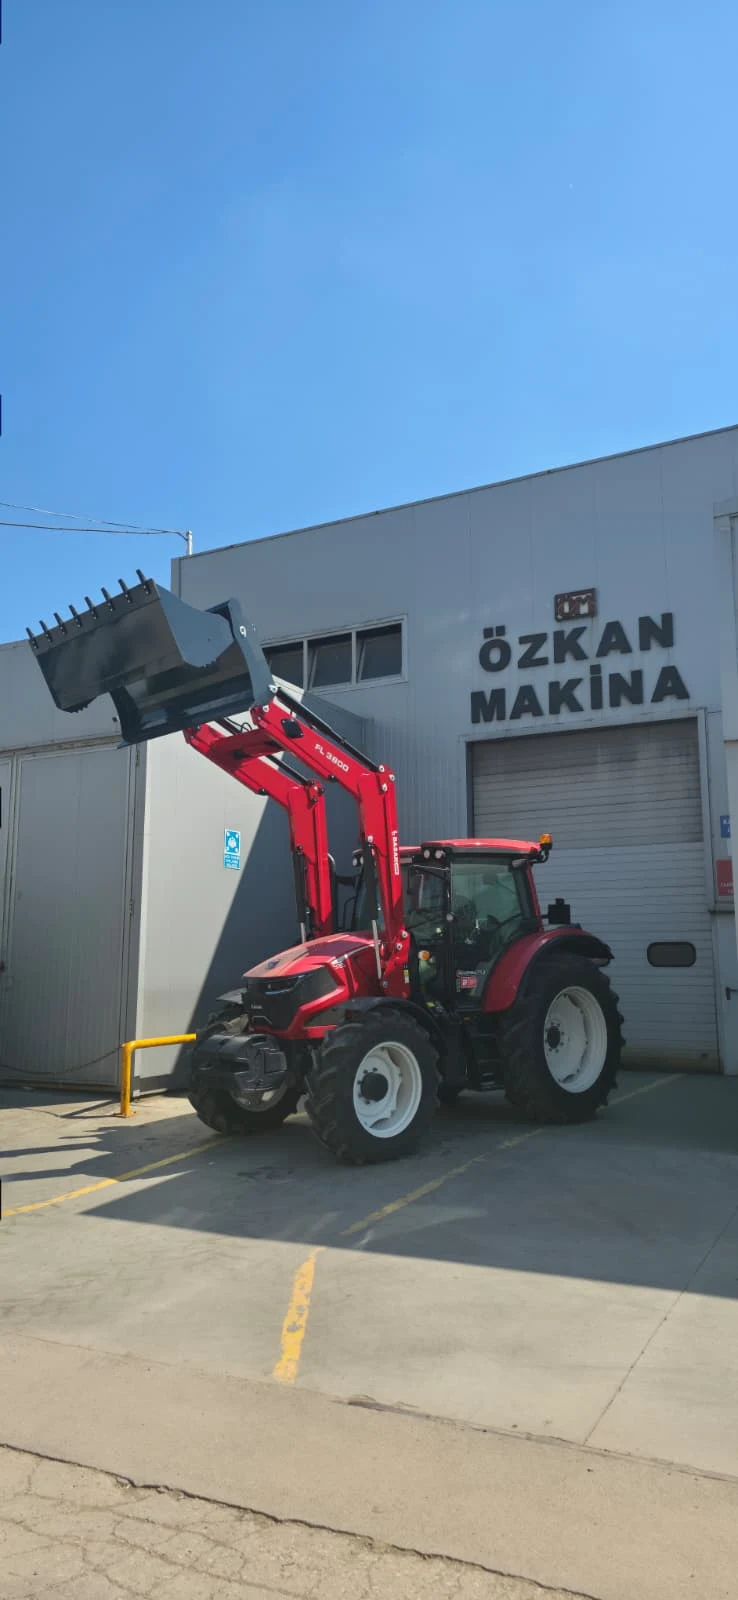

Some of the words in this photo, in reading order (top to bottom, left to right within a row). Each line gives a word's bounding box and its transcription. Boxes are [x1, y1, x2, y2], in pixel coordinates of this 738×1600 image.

[479, 613, 674, 672] ÖZKAN
[471, 664, 690, 724] MAKİNA
[314, 743, 325, 756] FL
